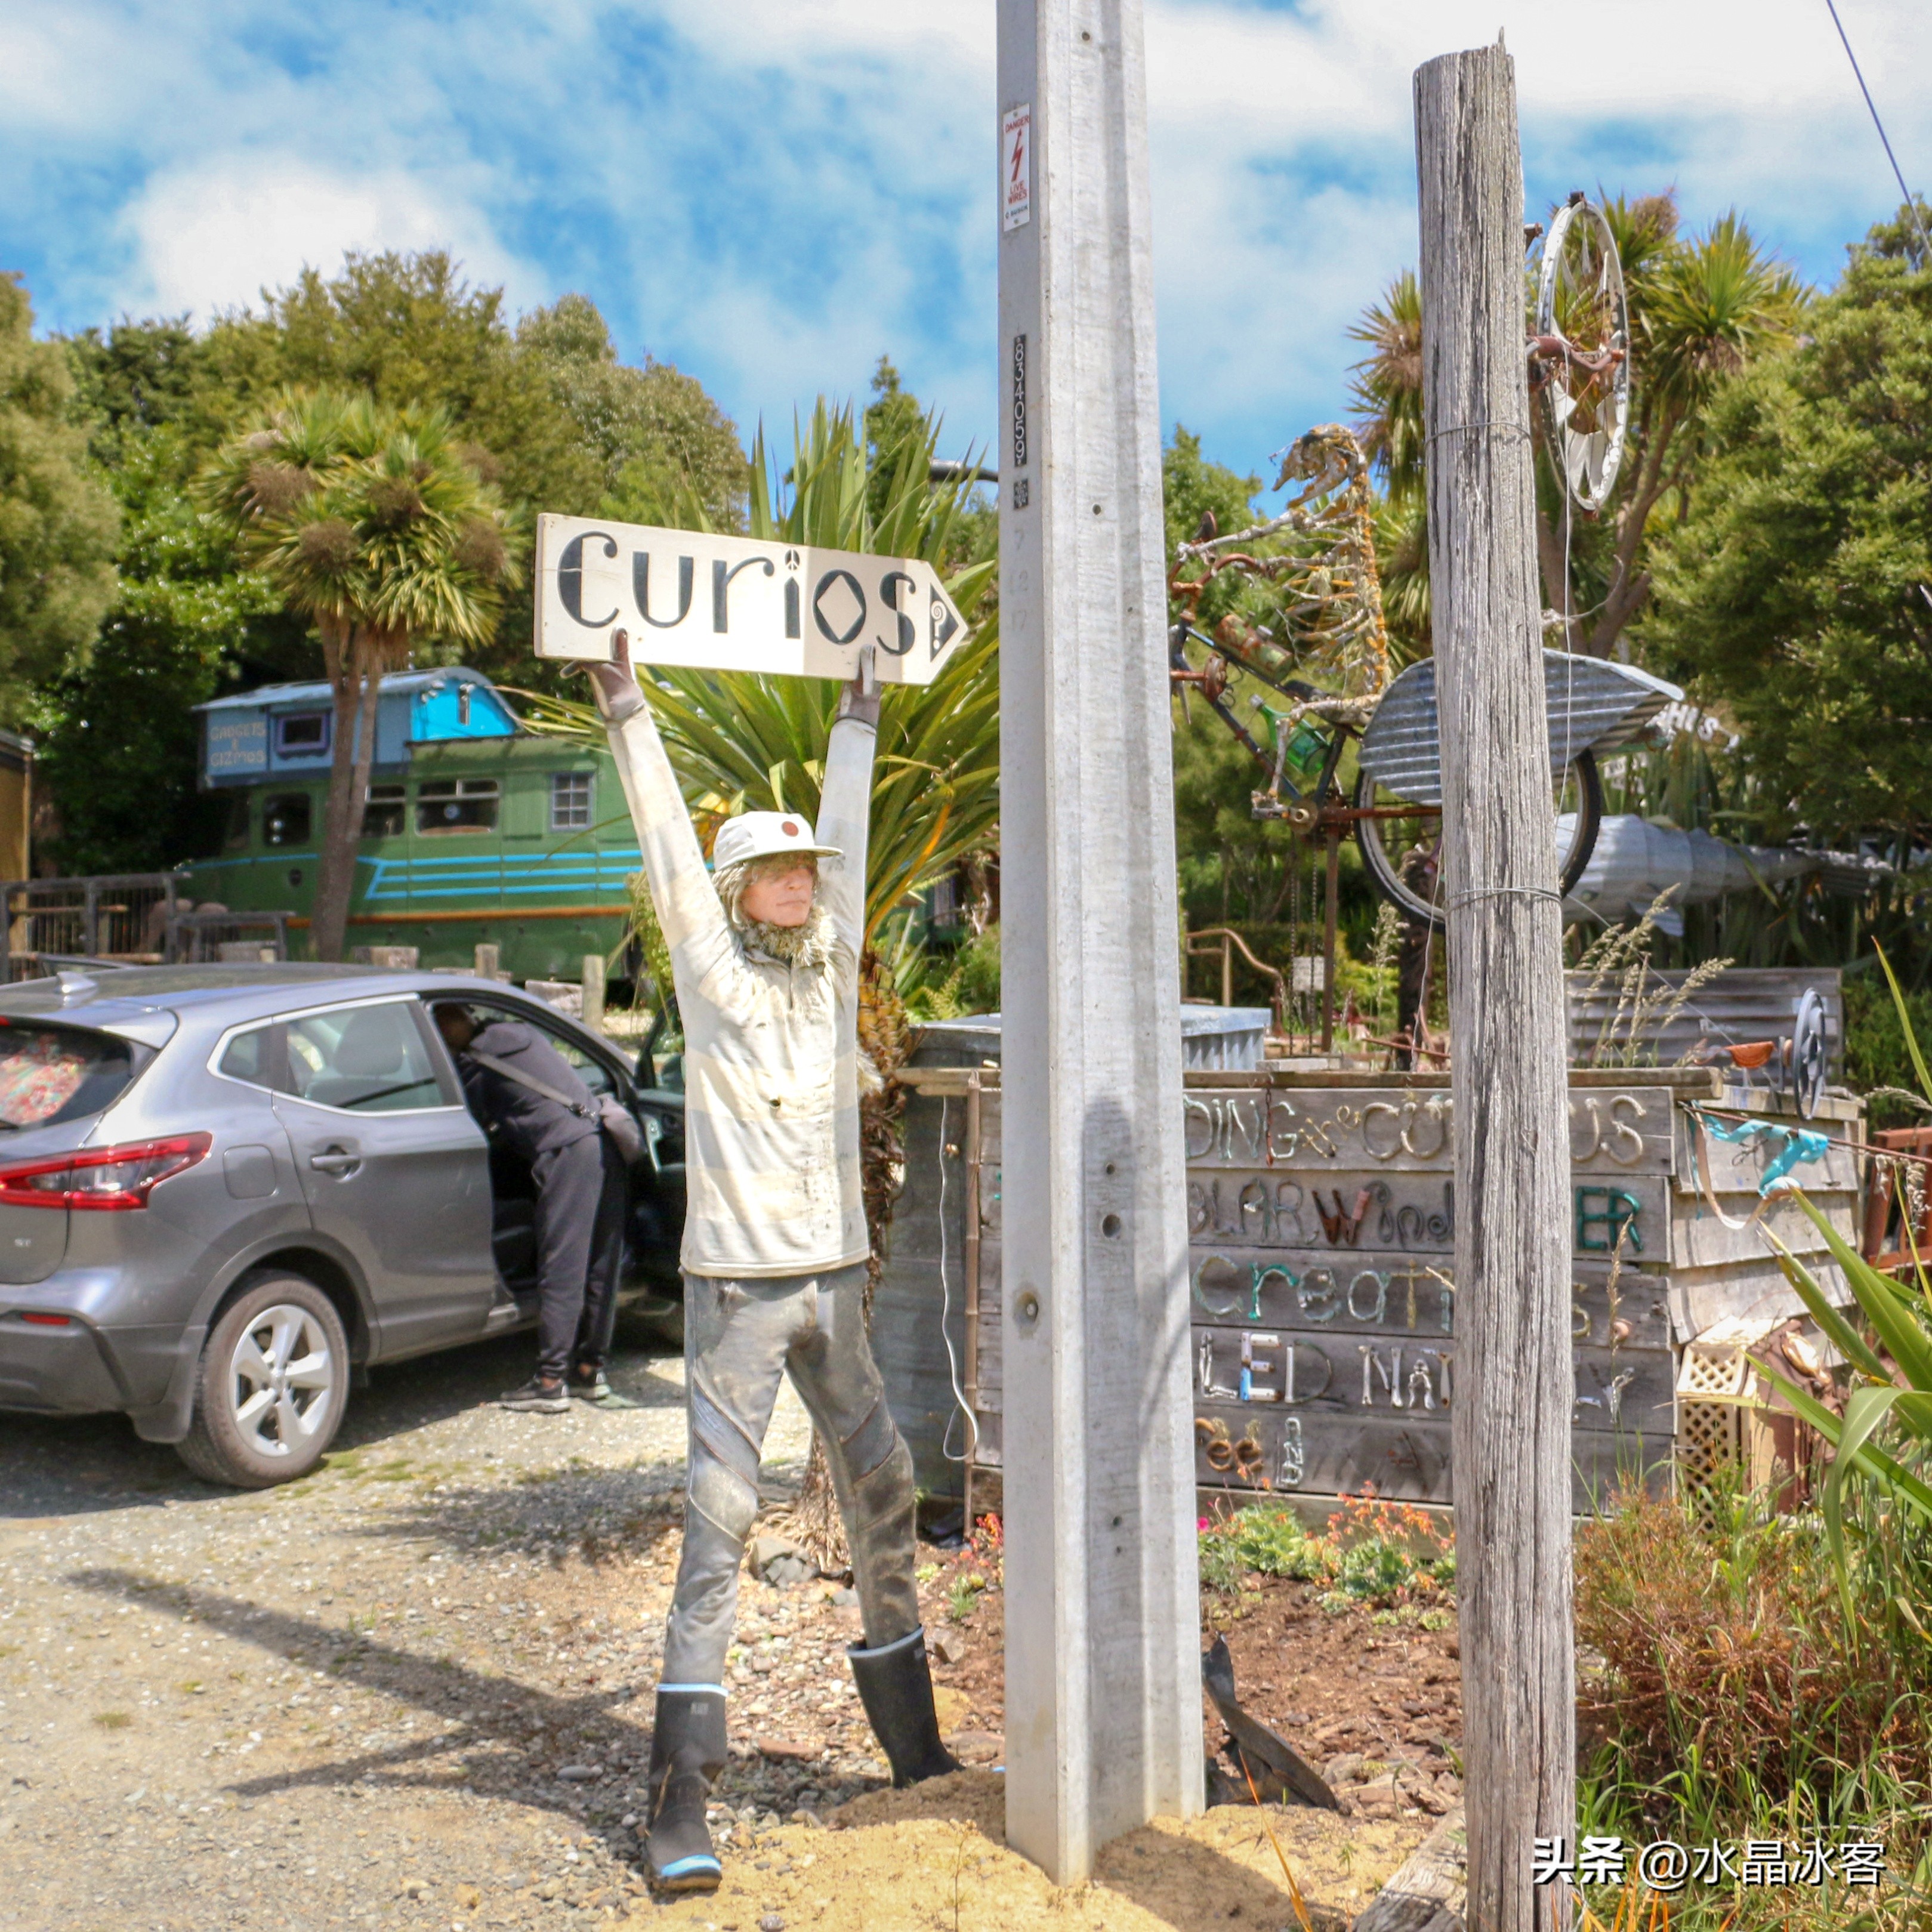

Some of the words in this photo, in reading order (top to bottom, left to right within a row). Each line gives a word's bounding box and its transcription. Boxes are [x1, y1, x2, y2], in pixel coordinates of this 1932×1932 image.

[1005, 115, 1029, 132] DANGER
[1010, 180, 1024, 195] LIVE
[1007, 189, 1027, 205] WIRES
[1015, 344, 1024, 459] 834059
[1183, 1093, 1298, 1160] DING
